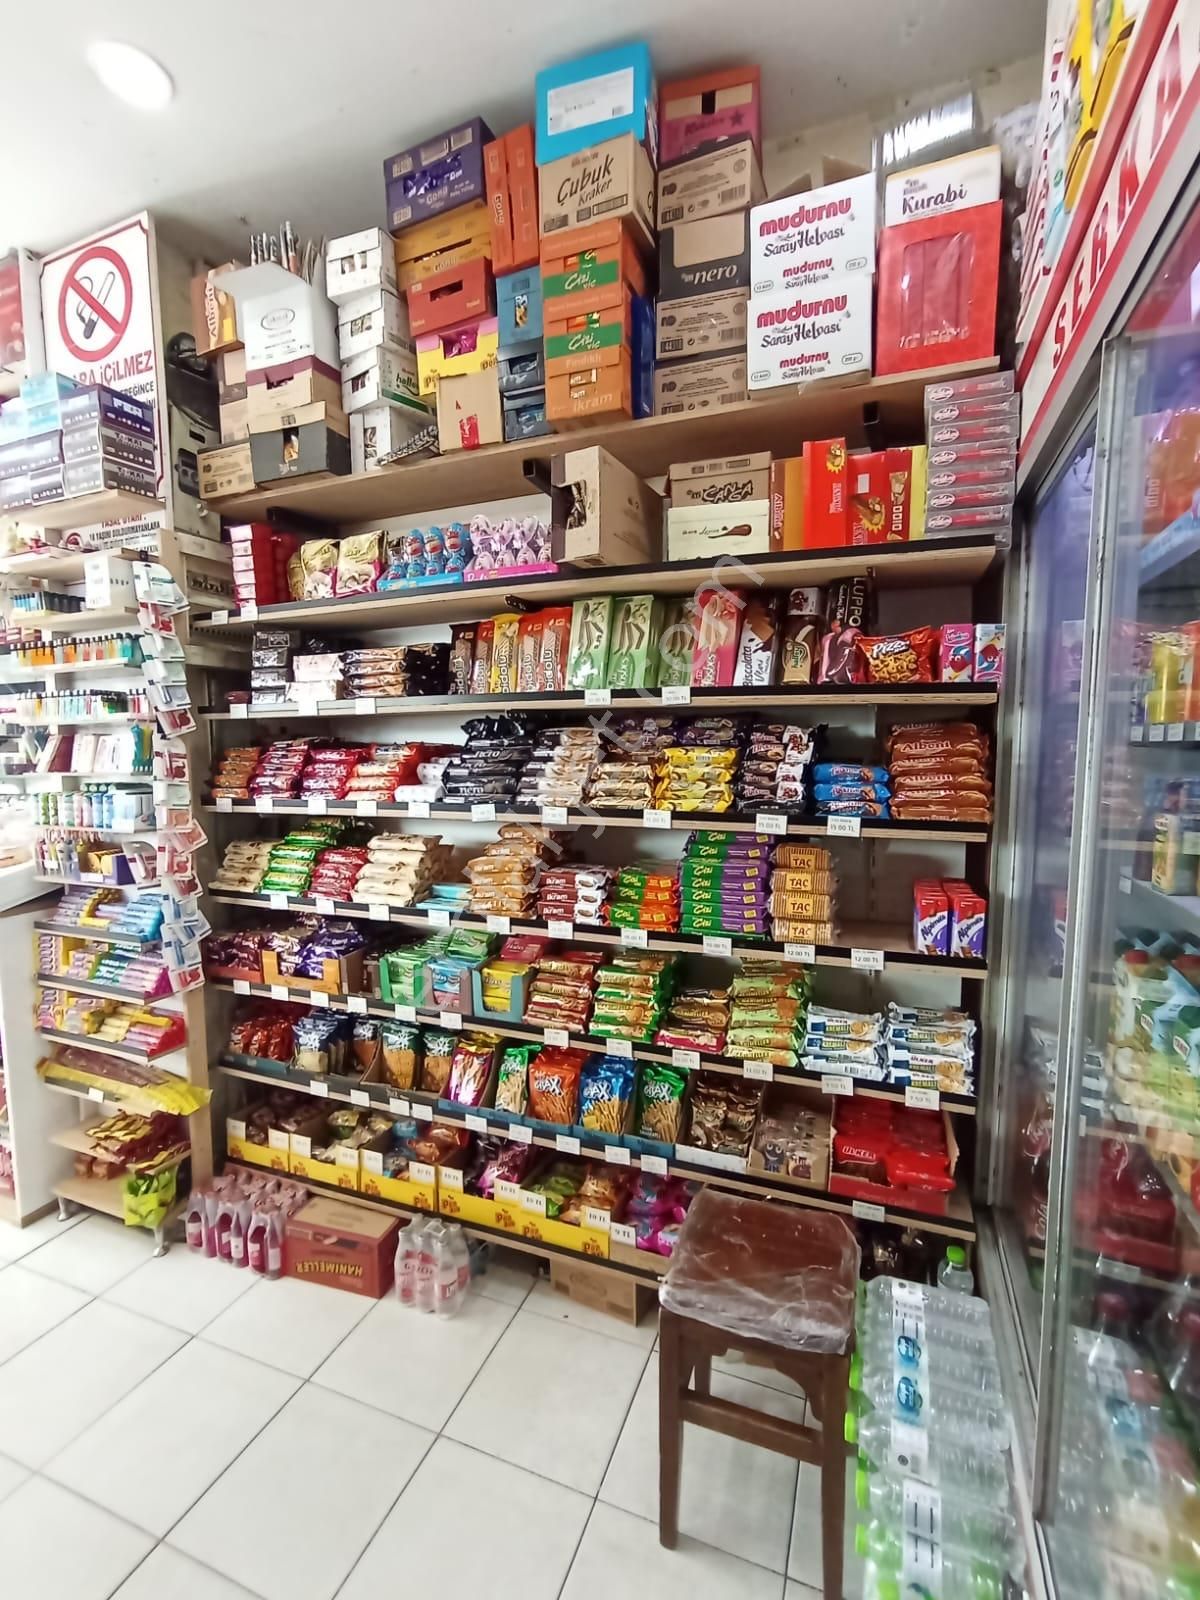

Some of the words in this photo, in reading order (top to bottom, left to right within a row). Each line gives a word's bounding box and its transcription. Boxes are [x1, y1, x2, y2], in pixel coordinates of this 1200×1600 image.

[557, 153, 614, 206] Çubuk
[578, 179, 612, 206] Kraker
[902, 184, 967, 215] Kurabi
[759, 197, 852, 237] mudurnu
[763, 241, 798, 257] Saray
[694, 264, 737, 285] nero
[782, 258, 832, 278] mudurnu
[757, 294, 848, 328] mudurnu
[760, 333, 795, 348] Saray
[780, 352, 829, 368] mudurnu
[702, 481, 753, 503] CANGA
[901, 741, 952, 752] Albeni
[296, 1261, 363, 1277] HANIMELLER
